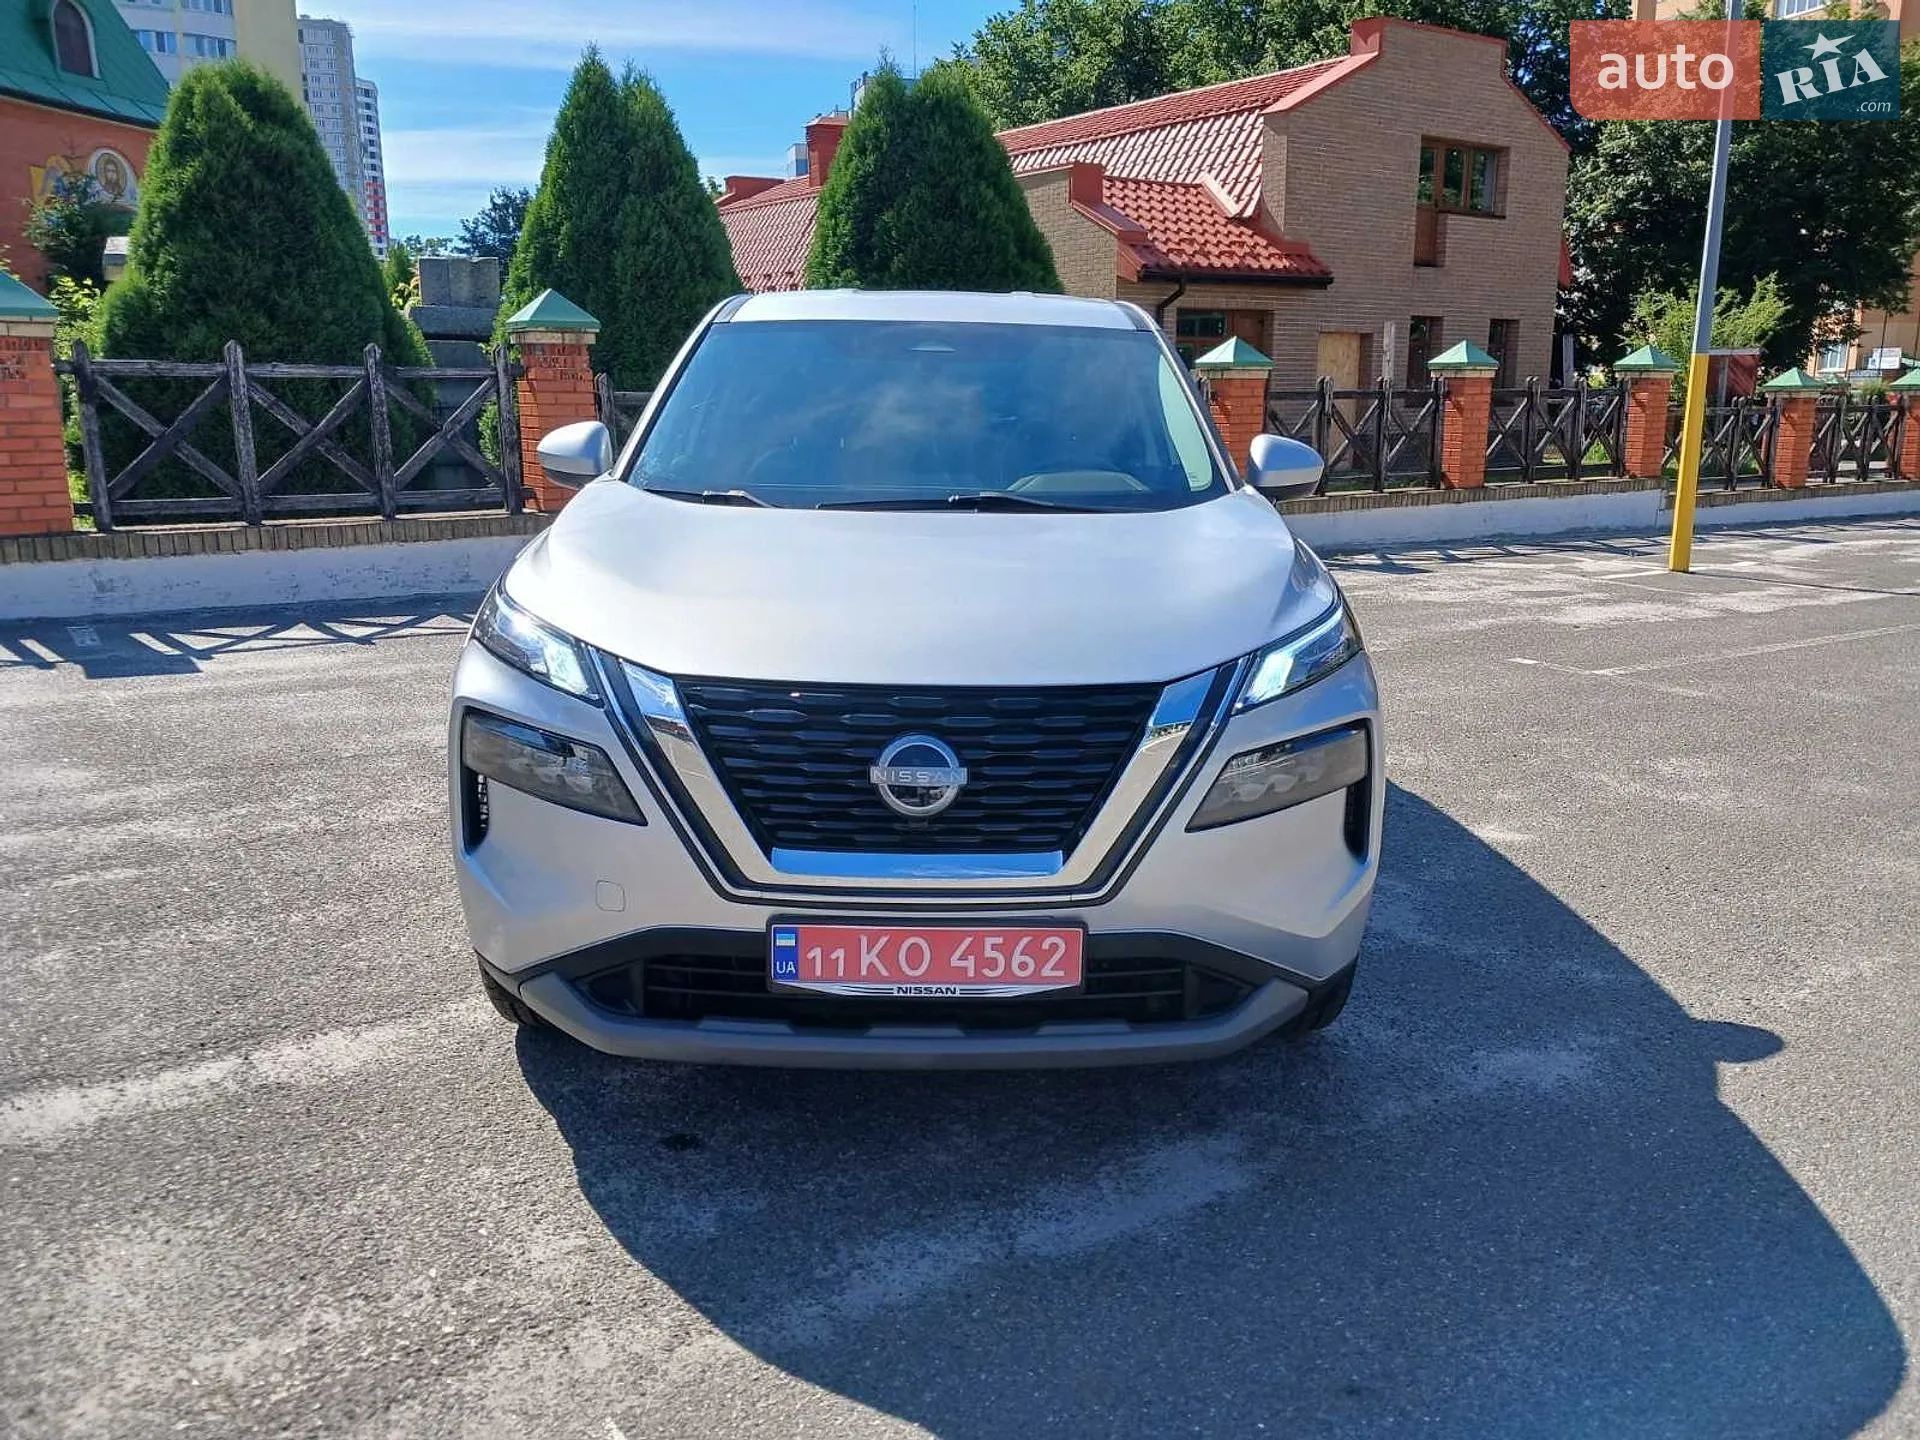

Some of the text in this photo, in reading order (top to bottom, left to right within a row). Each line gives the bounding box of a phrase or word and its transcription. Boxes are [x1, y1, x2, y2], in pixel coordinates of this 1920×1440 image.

[873, 769, 963, 783] NISSAN
[950, 936, 1067, 977] 4562
[776, 961, 796, 974] UA
[896, 986, 957, 995] NISSAN
